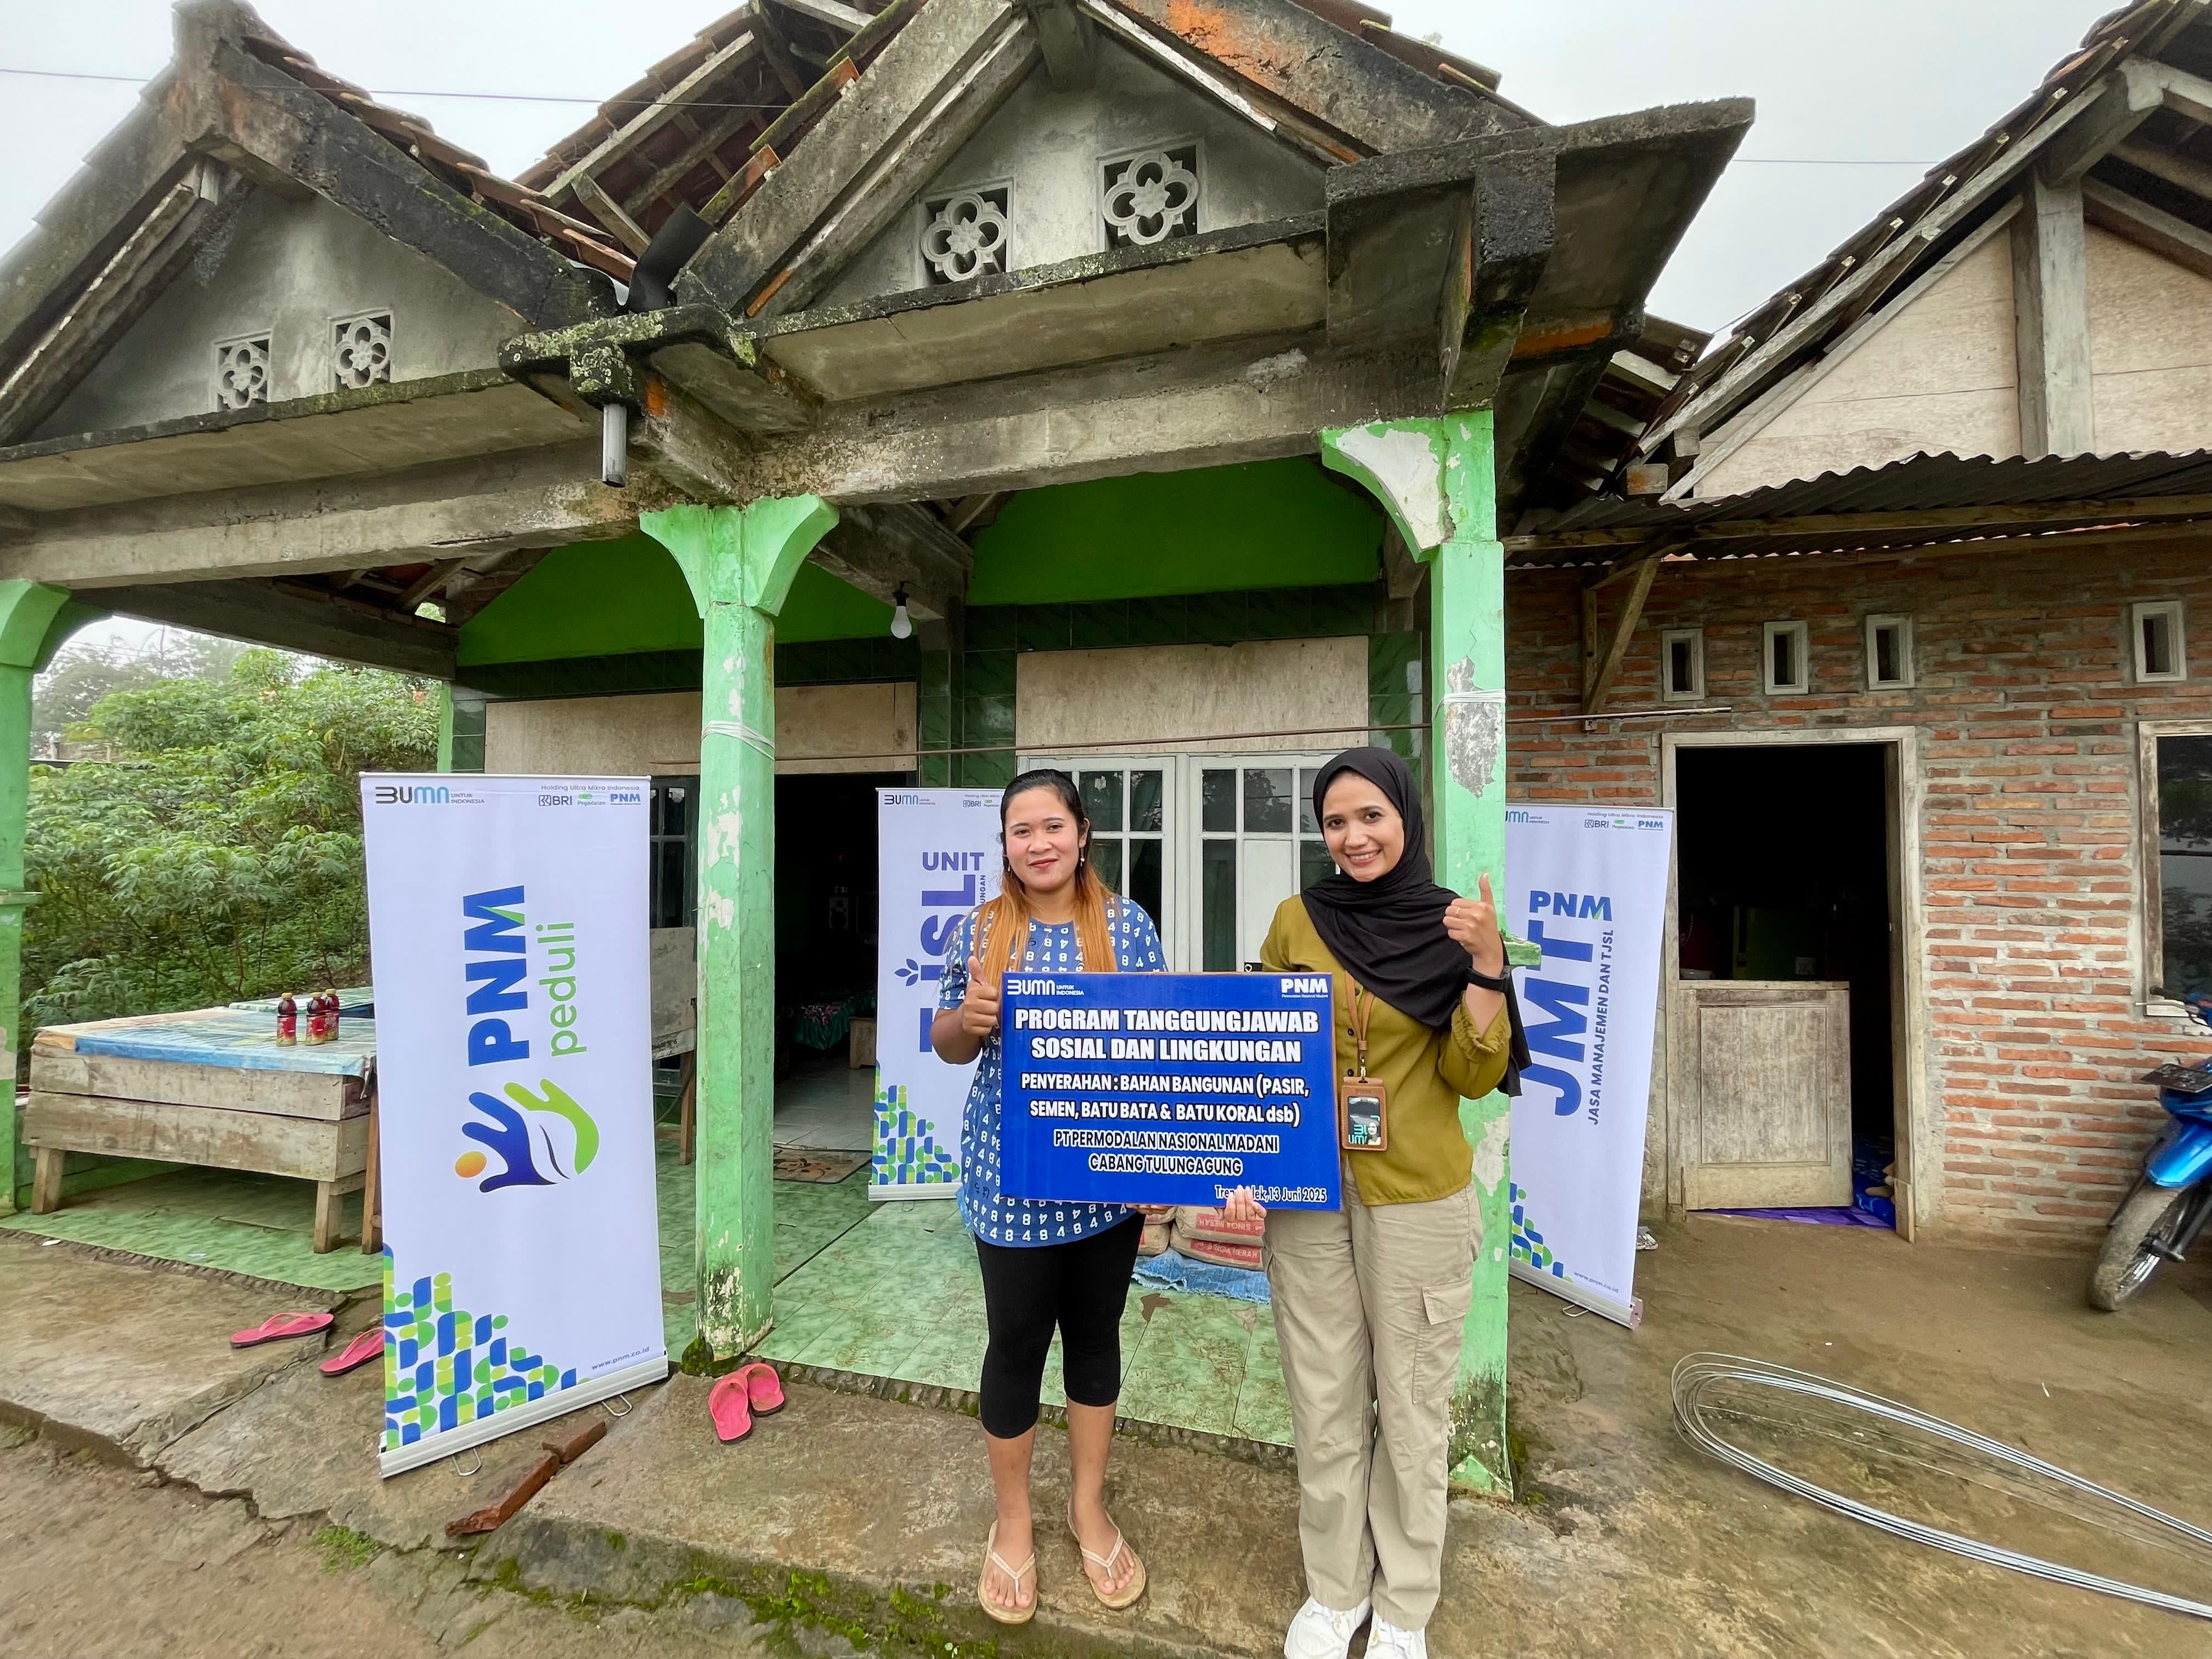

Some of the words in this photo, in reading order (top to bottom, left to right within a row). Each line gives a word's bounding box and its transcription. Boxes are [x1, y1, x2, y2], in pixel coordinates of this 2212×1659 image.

[552, 795, 572, 805] BRI
[610, 793, 641, 802] PNM
[1594, 820, 1609, 828] BRI
[1638, 820, 1663, 828] PNM
[923, 852, 985, 871] UNIT
[1529, 890, 1613, 922] PNM
[1601, 929, 1614, 962] TJSL
[463, 884, 530, 1067] PNM
[1281, 978, 1329, 994] PNM
[1599, 963, 1611, 994] DAN
[535, 922, 588, 1057] peduli
[1015, 1008, 1120, 1031] PROGRAM
[1123, 1009, 1319, 1032] TANGGUNGJAWAB
[1031, 1037, 1107, 1059] SOSIAL
[1111, 1038, 1155, 1060] DAN
[1159, 1039, 1301, 1063] LINGKUNGAN
[1592, 997, 1609, 1086] MANAJEMEN
[1120, 1075, 1170, 1092] BAHAN
[1172, 1076, 1254, 1093] BANGUNAN
[1256, 1073, 1310, 1098] (PASIR,
[1030, 1101, 1079, 1120] SEMEN,
[1081, 1101, 1118, 1118] BATU
[1120, 1102, 1158, 1119] BATA
[1159, 1103, 1172, 1120] &
[1176, 1104, 1214, 1121] BATU
[1216, 1105, 1265, 1122] KORAL
[1266, 1102, 1300, 1128] dsb)
[1588, 1089, 1601, 1125] JASA
[1054, 1130, 1069, 1145] PT
[1072, 1131, 1156, 1148] PERMODALAN
[1159, 1134, 1224, 1150] NASIONAL
[1225, 1136, 1279, 1152] MADANI
[1090, 1155, 1143, 1171] CABANG
[1146, 1157, 1242, 1175] TULUNGAGUNG
[1283, 1188, 1301, 1201] Juni
[1304, 1189, 1327, 1202] 2025
[591, 1346, 650, 1370] www.pnm.co.id
